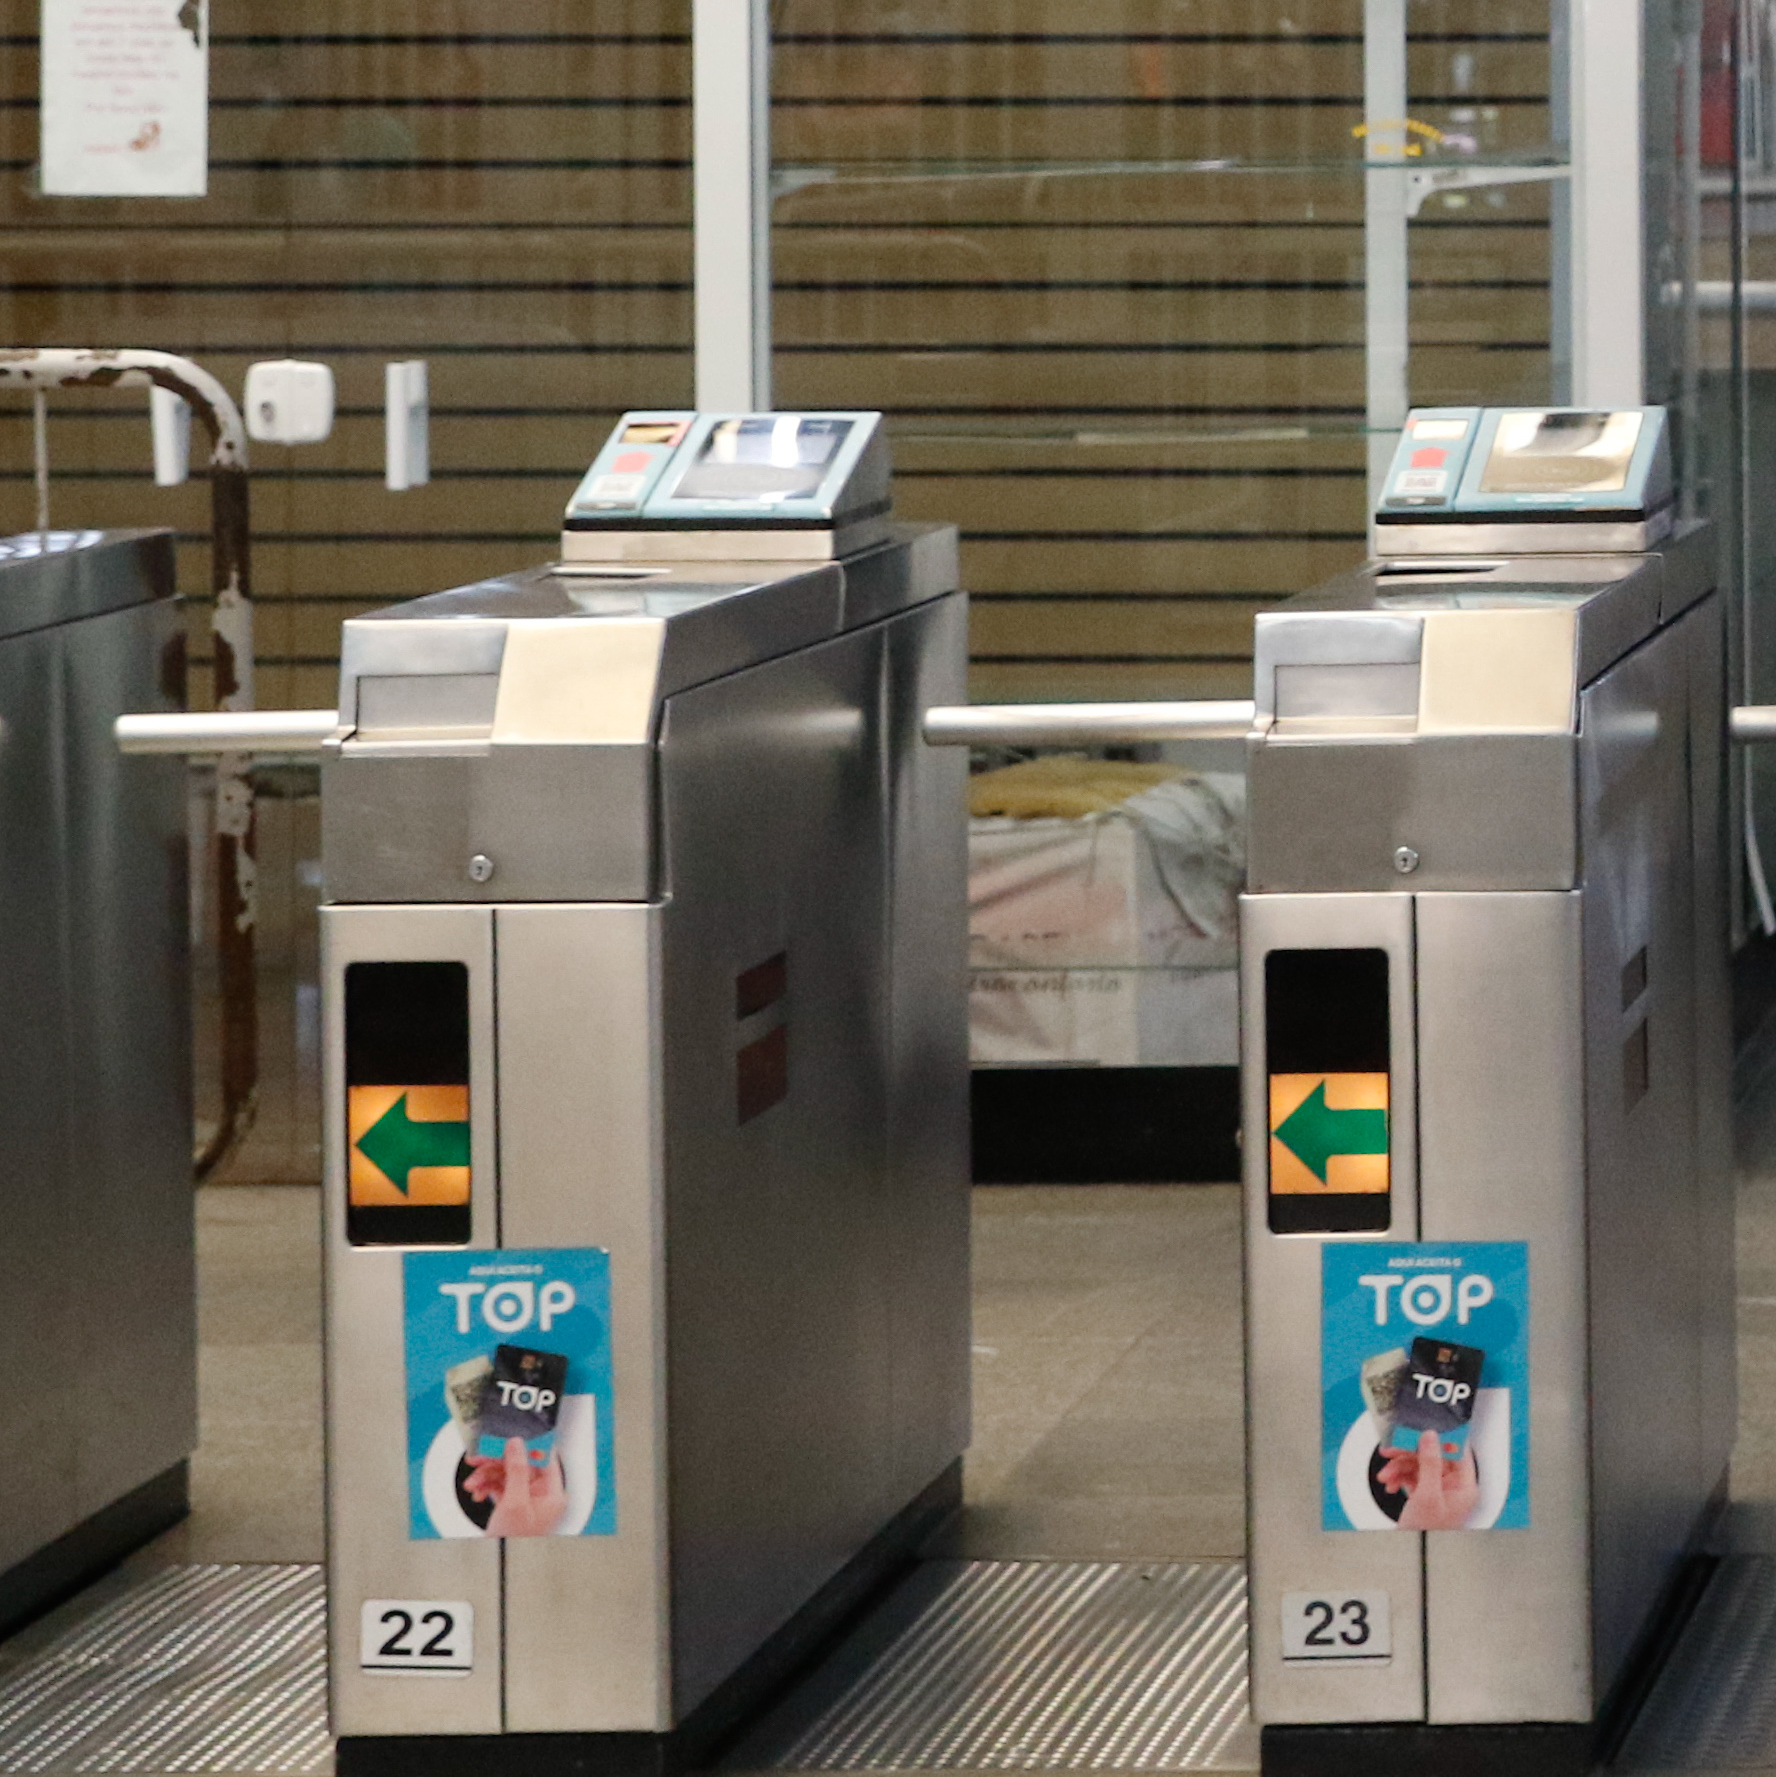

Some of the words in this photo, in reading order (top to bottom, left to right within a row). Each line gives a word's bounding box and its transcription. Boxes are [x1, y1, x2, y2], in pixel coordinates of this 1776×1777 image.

[439, 1281, 576, 1333] TOP
[1359, 1273, 1494, 1325] TOP
[497, 1381, 556, 1413] TOP
[1413, 1373, 1470, 1406] TOP
[379, 1609, 455, 1657] 22
[1303, 1599, 1370, 1646] 23
